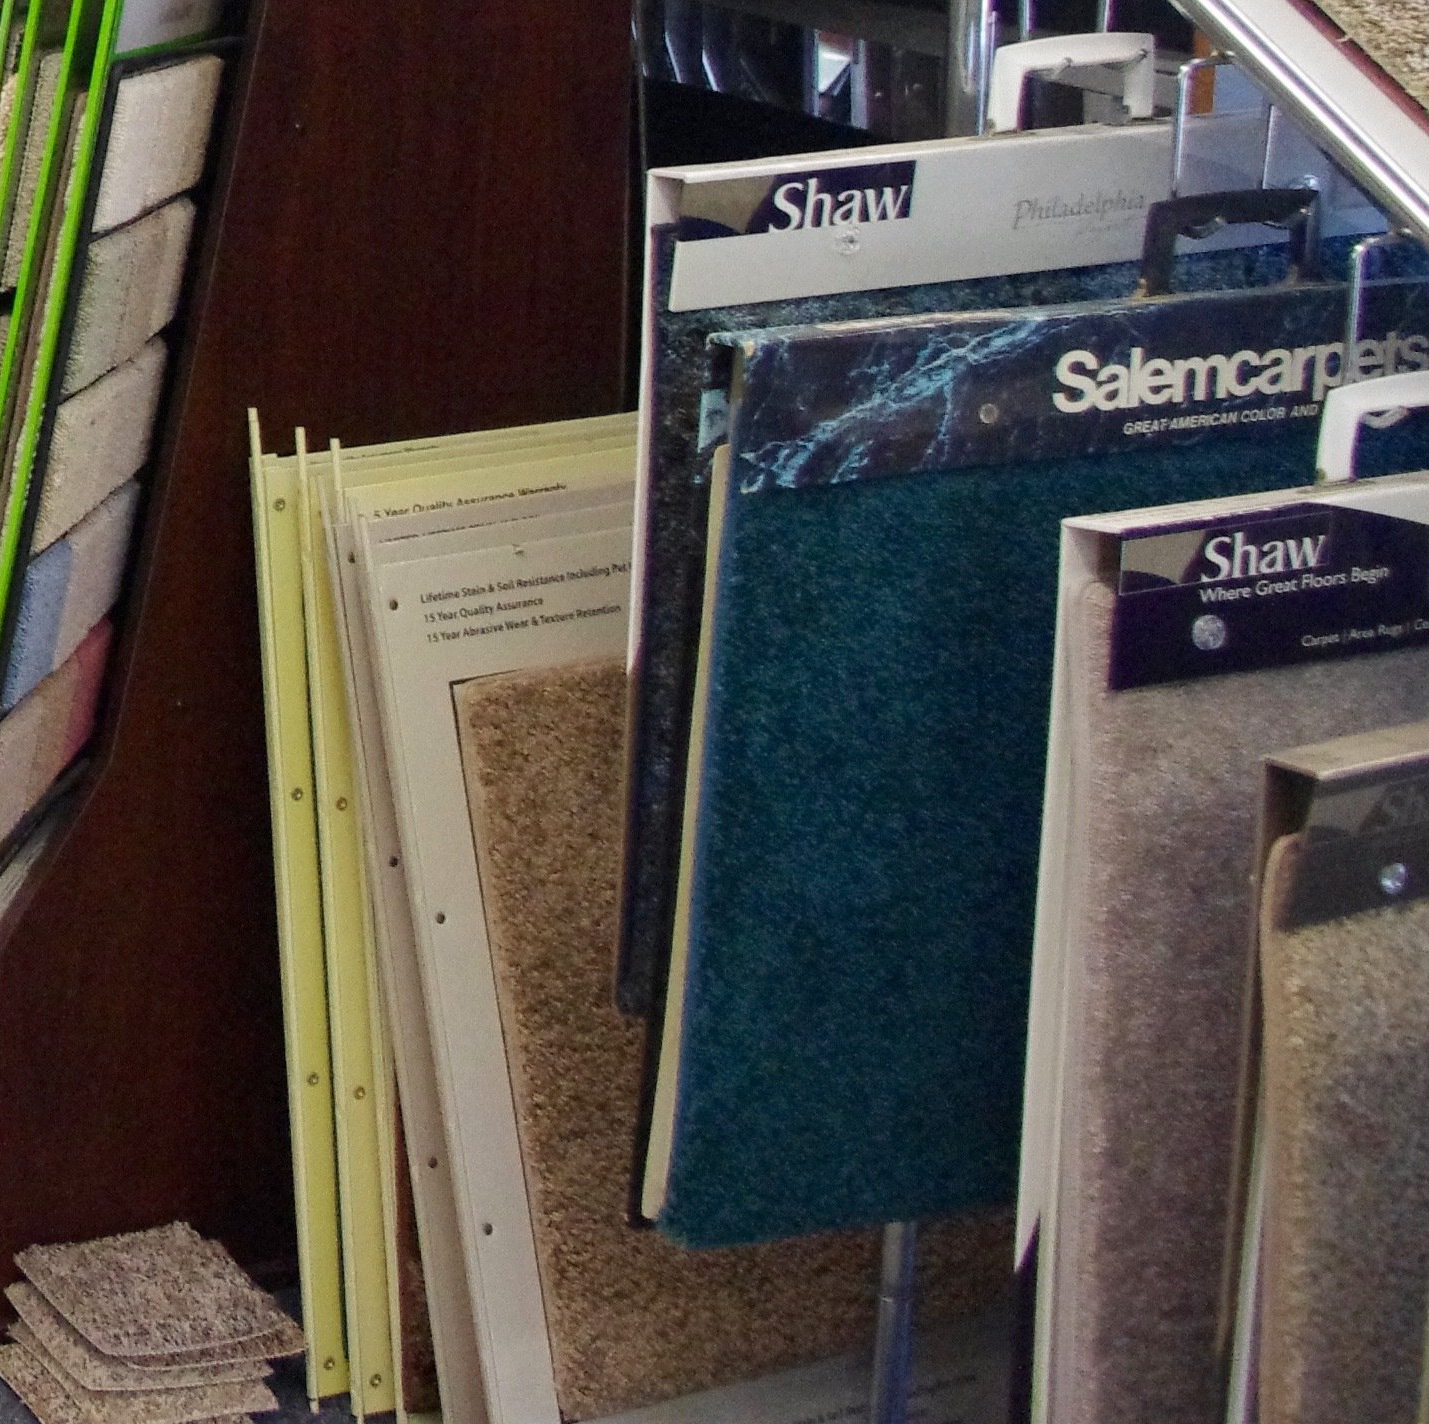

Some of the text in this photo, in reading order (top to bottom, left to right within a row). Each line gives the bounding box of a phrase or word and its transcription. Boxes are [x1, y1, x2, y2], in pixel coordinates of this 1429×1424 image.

[768, 177, 911, 232] Shaw
[1013, 190, 1144, 230] Philadelphia
[1052, 332, 1429, 414] Salemcarpets
[1123, 403, 1320, 436] GREAT AMERICAN COLOR AND
[1201, 531, 1327, 583] Shaw
[420, 562, 627, 604] Lifetime Stain & Soil Resistance Including Pet
[1200, 565, 1390, 603] Where Great Floors Begin
[424, 597, 544, 624] 15 Year Quality Assurance
[427, 604, 622, 644] 15 Year Abrasive Wear & Texture Retention
[1301, 633, 1340, 648] Carpet
